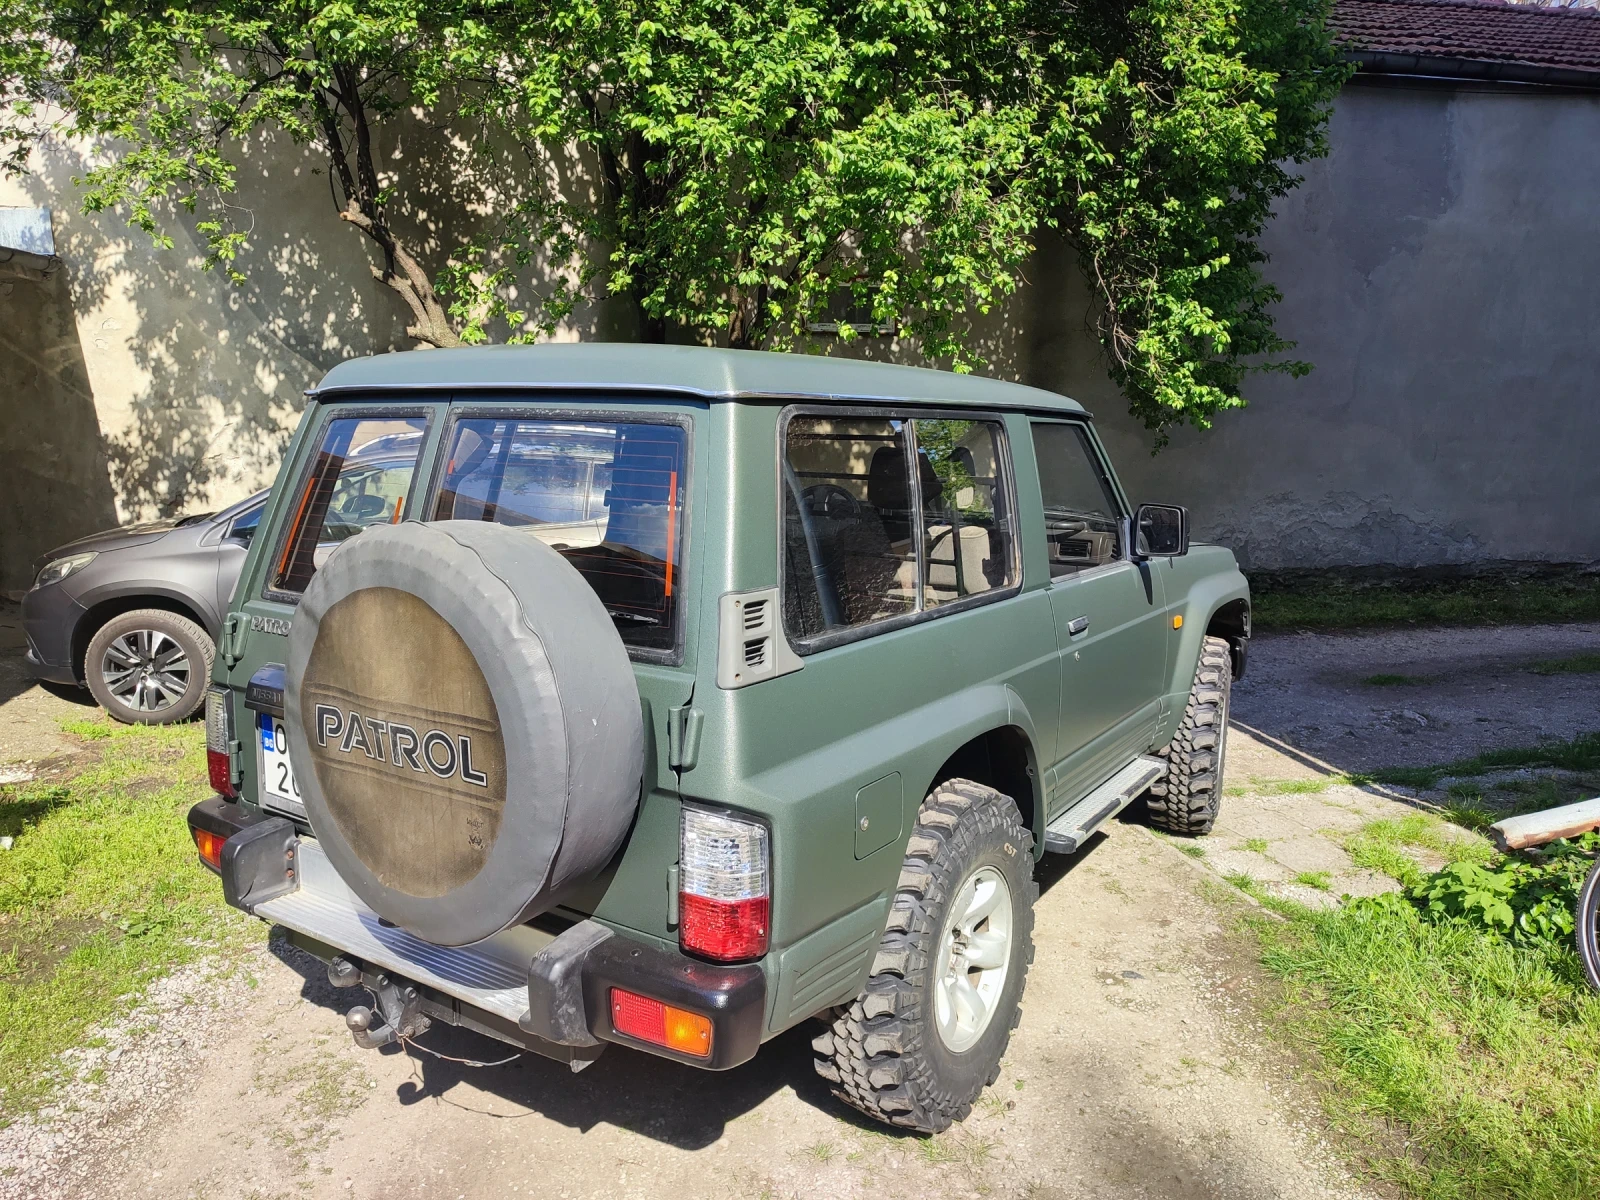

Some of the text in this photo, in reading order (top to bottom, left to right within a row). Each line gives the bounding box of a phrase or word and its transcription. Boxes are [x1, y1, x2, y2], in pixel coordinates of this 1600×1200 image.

[264, 737, 274, 749] BG
[314, 703, 488, 788] PATROL
[1003, 842, 1018, 858] CST
